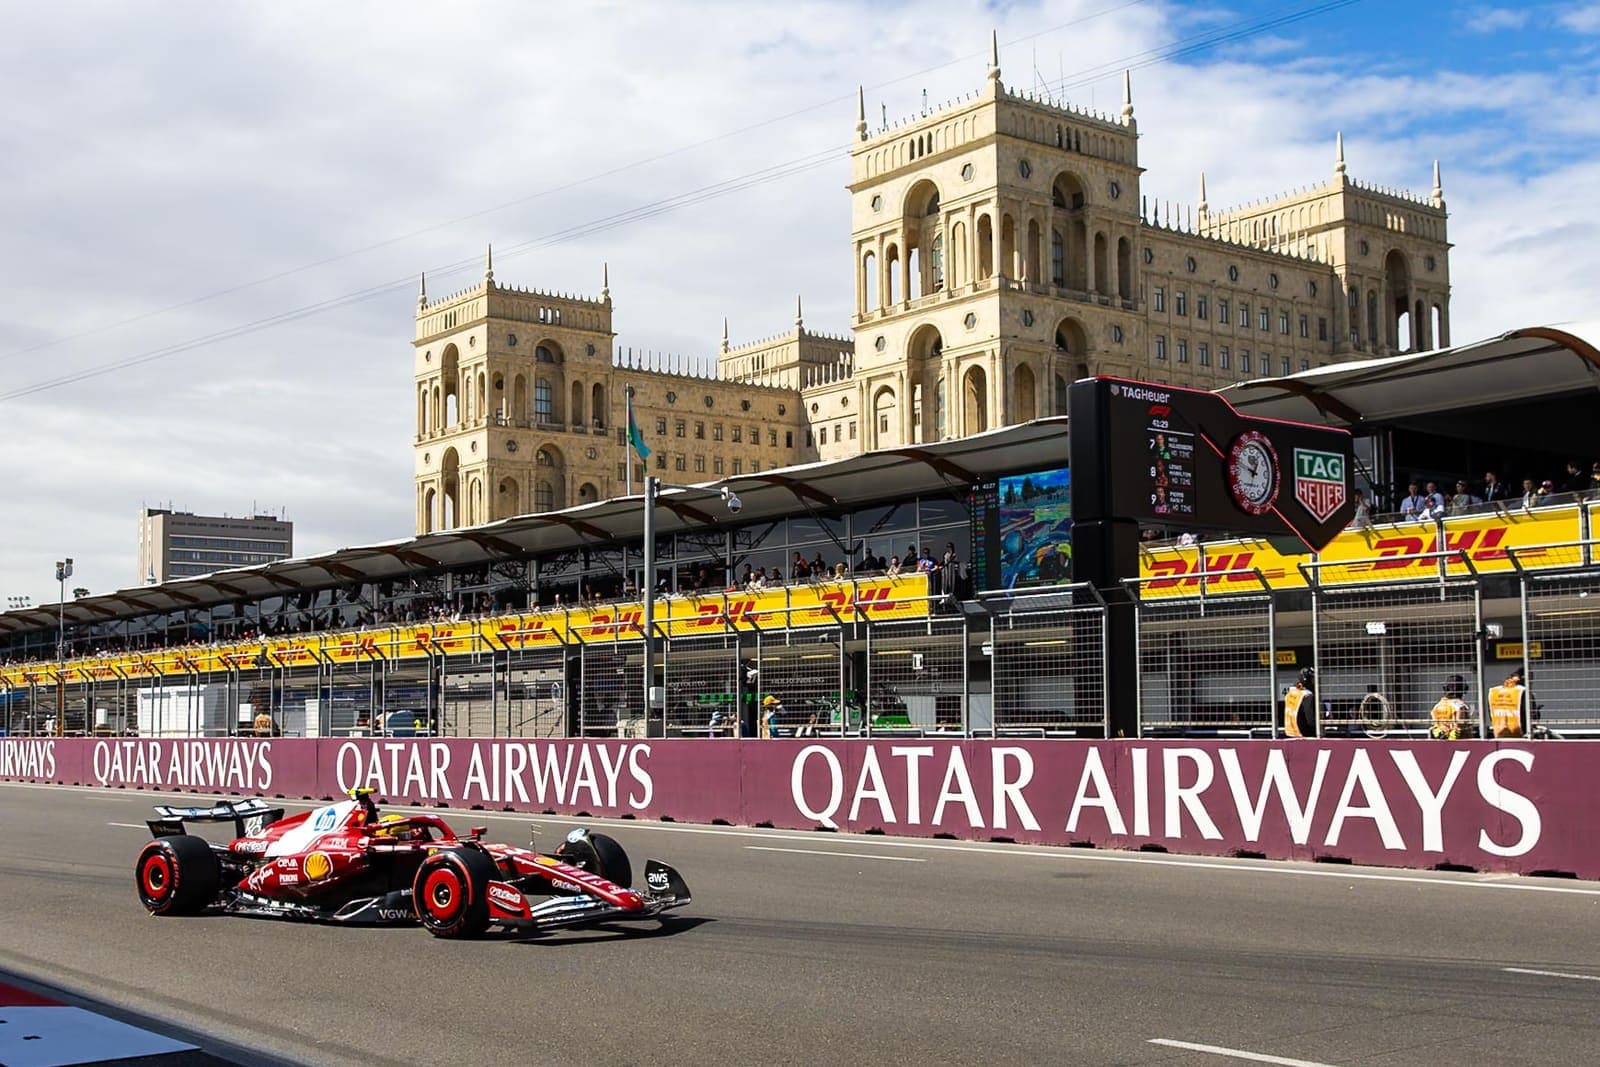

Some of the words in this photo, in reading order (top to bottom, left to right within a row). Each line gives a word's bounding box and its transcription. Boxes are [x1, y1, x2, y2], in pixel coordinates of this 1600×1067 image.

[1150, 439, 1156, 449] 7
[1150, 466, 1156, 477] 8
[1298, 454, 1341, 479] TAG
[1151, 494, 1157, 505] 9
[1299, 482, 1342, 517] HEUER
[1372, 527, 1509, 571] DHL
[1148, 552, 1268, 589] DHL
[697, 601, 759, 626] DHL
[820, 587, 896, 616] DHL
[499, 621, 547, 643] DHL
[591, 611, 645, 635] DHL
[340, 637, 376, 657] DHL
[414, 630, 454, 650] DHL
[94, 740, 162, 787] QATAR
[167, 741, 273, 789] AIRWAYS
[336, 742, 453, 799] QATAR
[463, 742, 653, 810] AIRWAYS
[791, 745, 1042, 832] QATAR
[1066, 746, 1542, 857] AIRWAYS
[647, 873, 668, 883] aws
[379, 909, 407, 920] VGW
